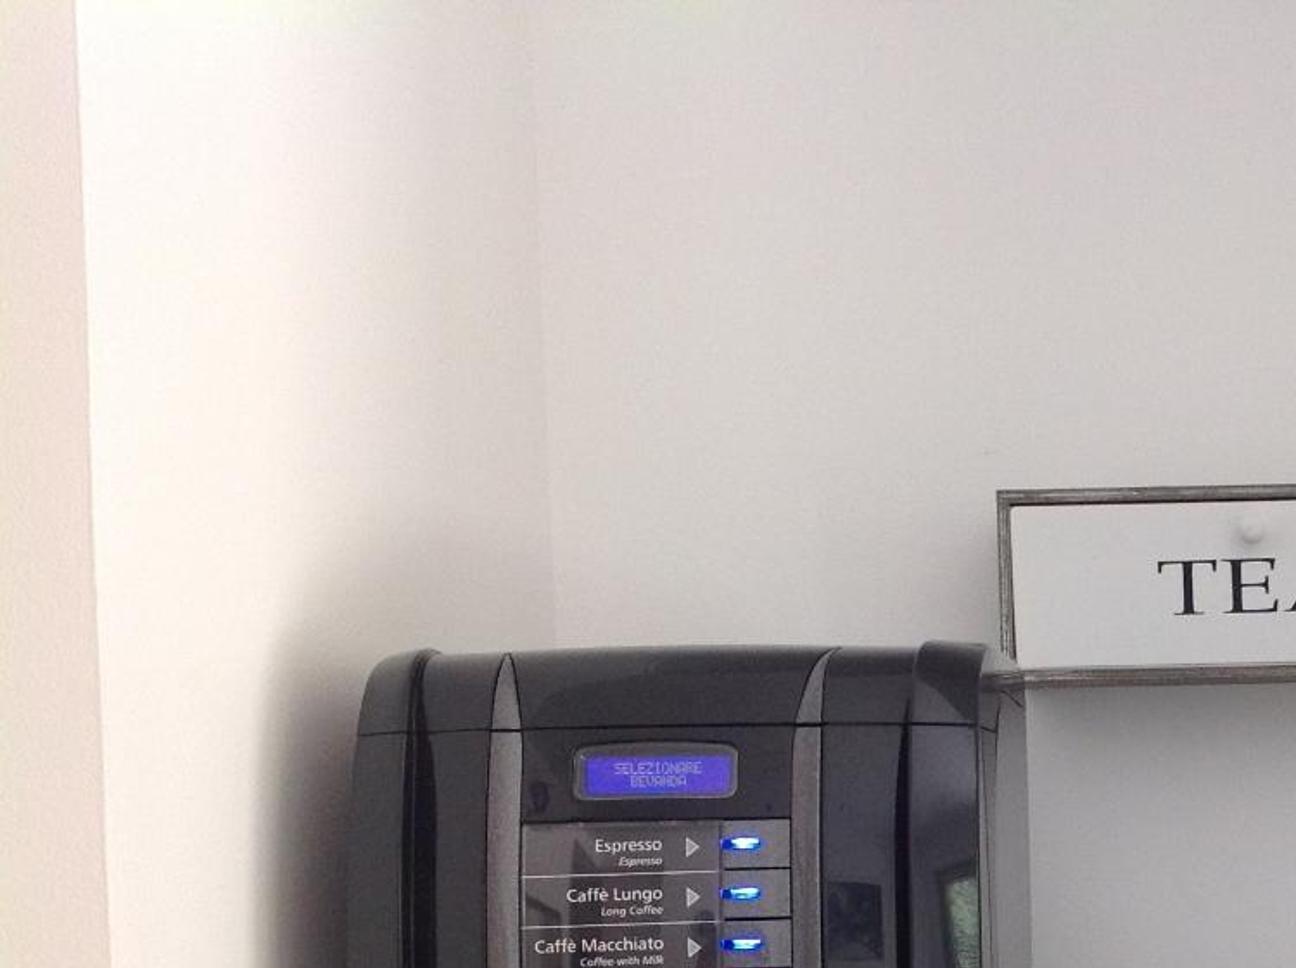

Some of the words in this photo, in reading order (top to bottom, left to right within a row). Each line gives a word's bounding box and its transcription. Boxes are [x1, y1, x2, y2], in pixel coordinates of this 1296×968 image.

[613, 760, 703, 775] SELEZIONARE
[629, 774, 688, 788] BEVANDA
[594, 838, 663, 854] Espresso
[618, 856, 663, 868] Espresso
[566, 887, 609, 904] Caffè
[612, 886, 664, 906] Lungo
[601, 905, 627, 919] Long
[628, 903, 664, 916] Coffee
[534, 937, 577, 955] Caffè
[581, 935, 665, 953] Macchiato
[580, 955, 614, 968] Coffee
[616, 954, 640, 966] with
